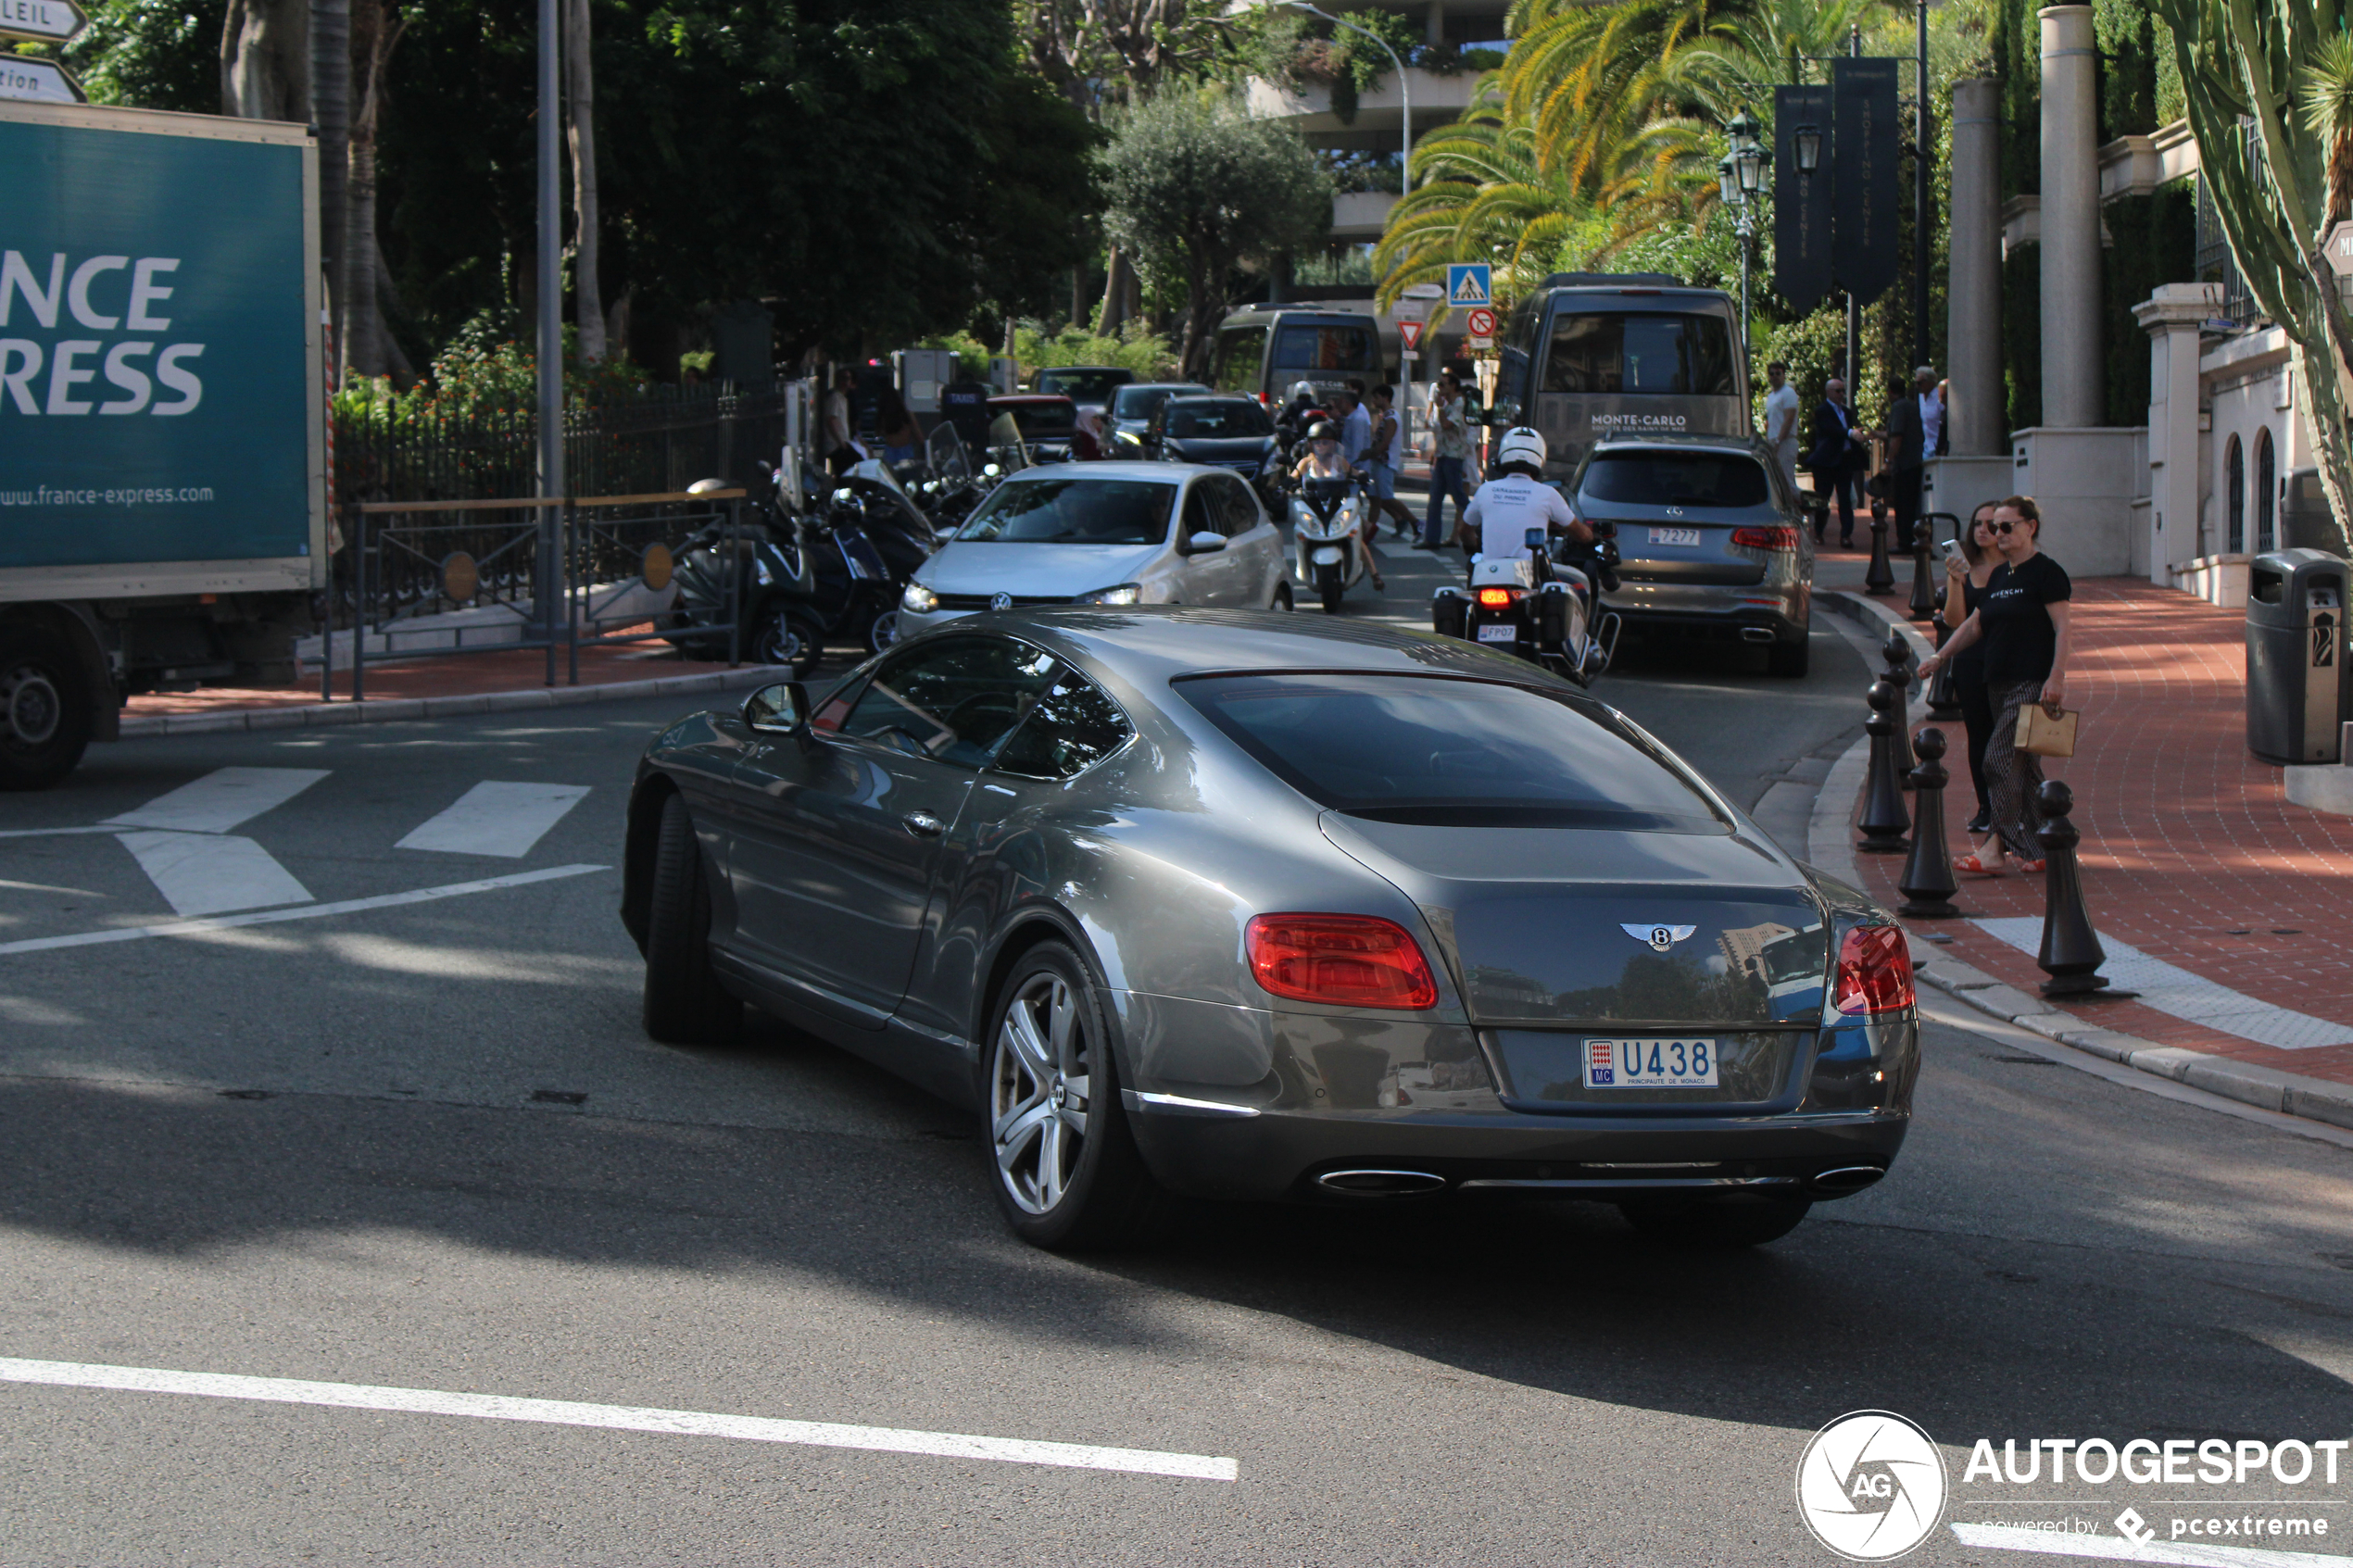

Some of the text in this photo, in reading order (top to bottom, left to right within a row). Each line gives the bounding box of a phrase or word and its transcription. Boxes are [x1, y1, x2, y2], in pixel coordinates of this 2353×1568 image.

[0, 250, 181, 332] NCE
[0, 338, 206, 416] RESS
[1663, 529, 1696, 543] 7277
[1488, 627, 1514, 637] FP07
[1622, 1041, 1710, 1076] U438
[1595, 1070, 1610, 1082] MC
